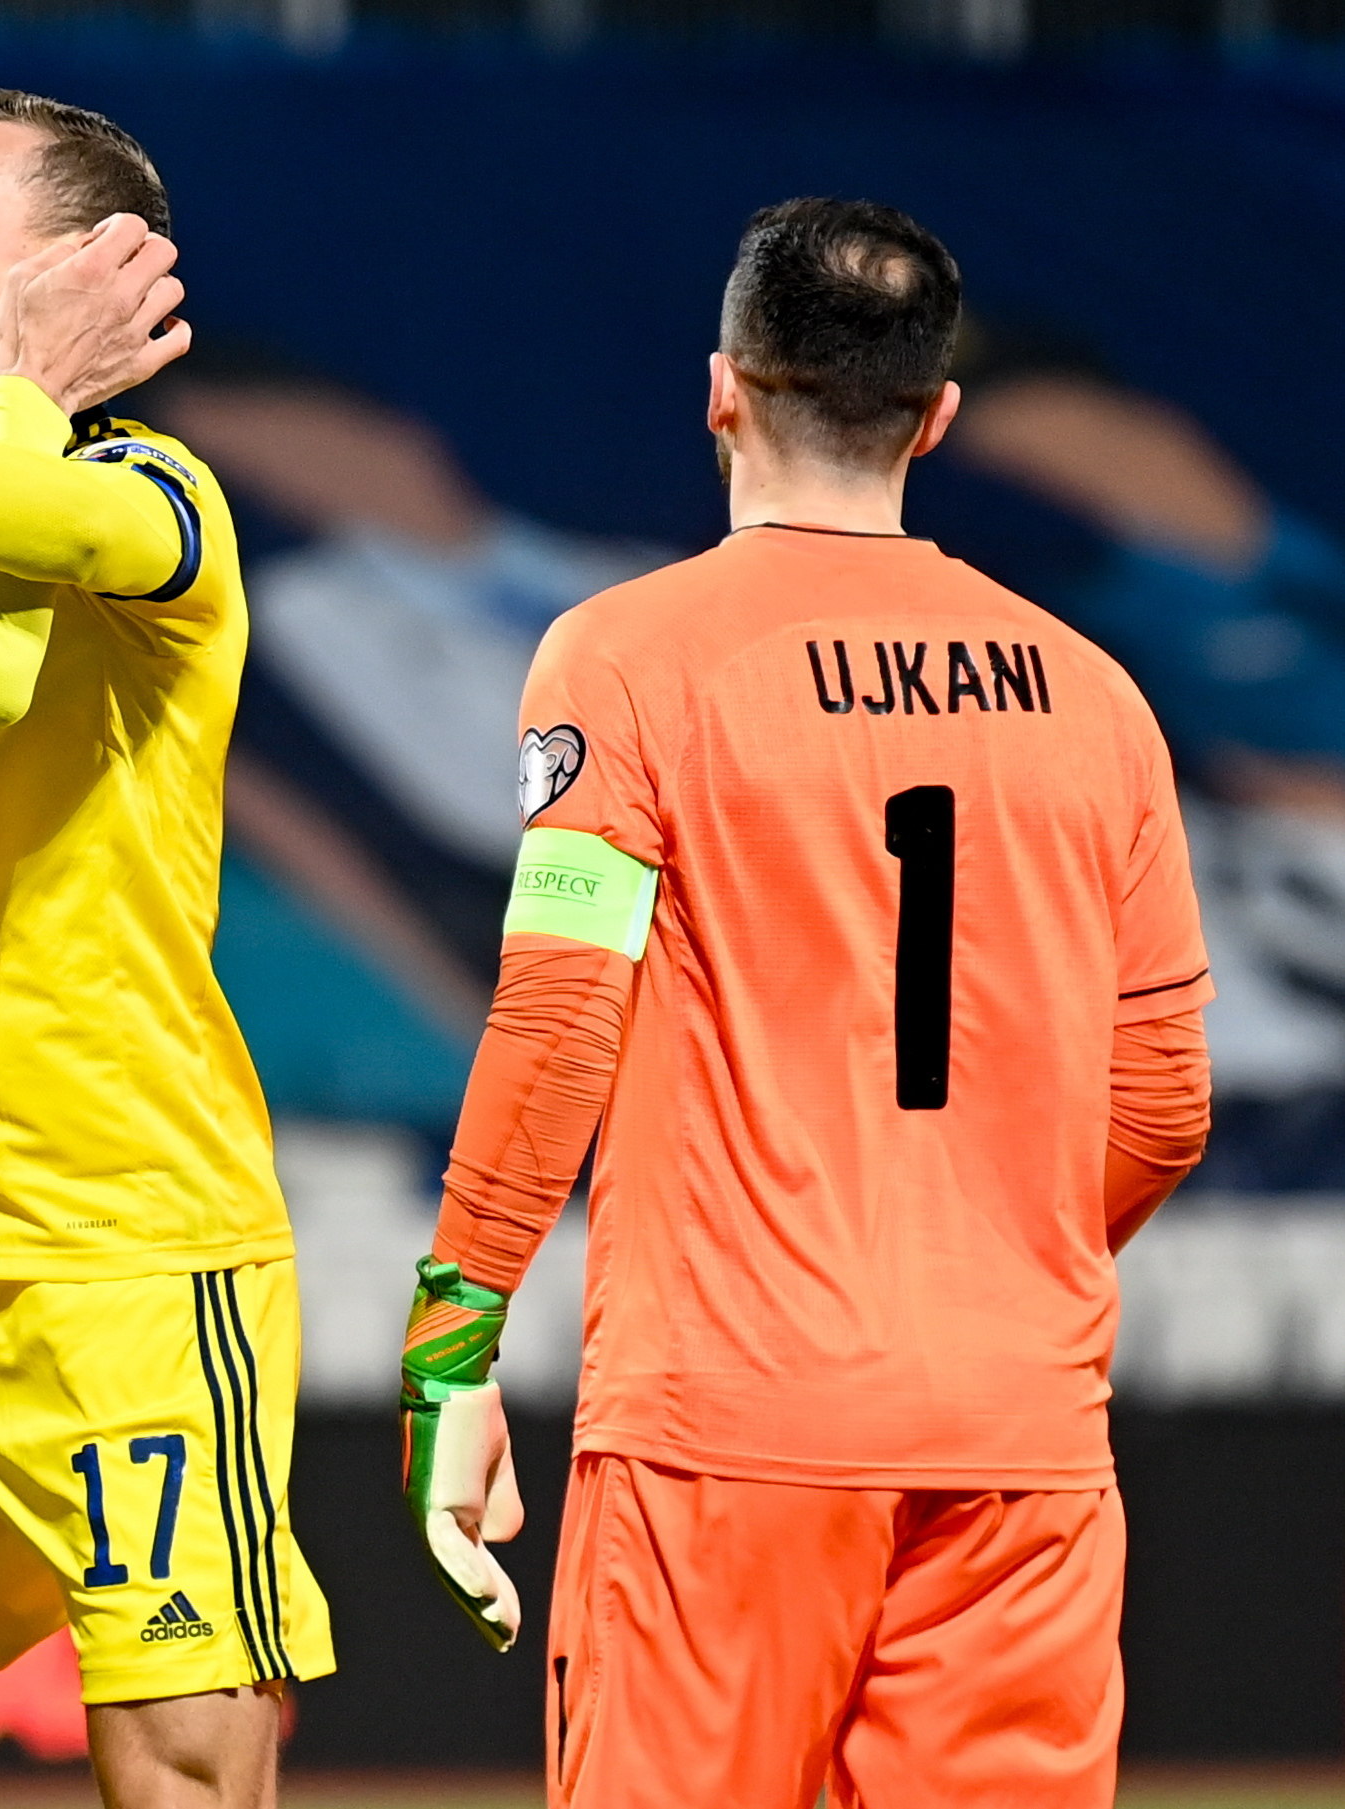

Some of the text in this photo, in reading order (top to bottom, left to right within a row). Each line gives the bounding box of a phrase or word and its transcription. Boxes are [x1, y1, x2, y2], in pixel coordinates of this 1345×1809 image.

[805, 640, 1052, 715] UJKANI
[517, 871, 602, 897] RESPECT
[885, 785, 955, 1110] 1
[71, 1434, 187, 1588] 17
[140, 1621, 214, 1643] adidas
